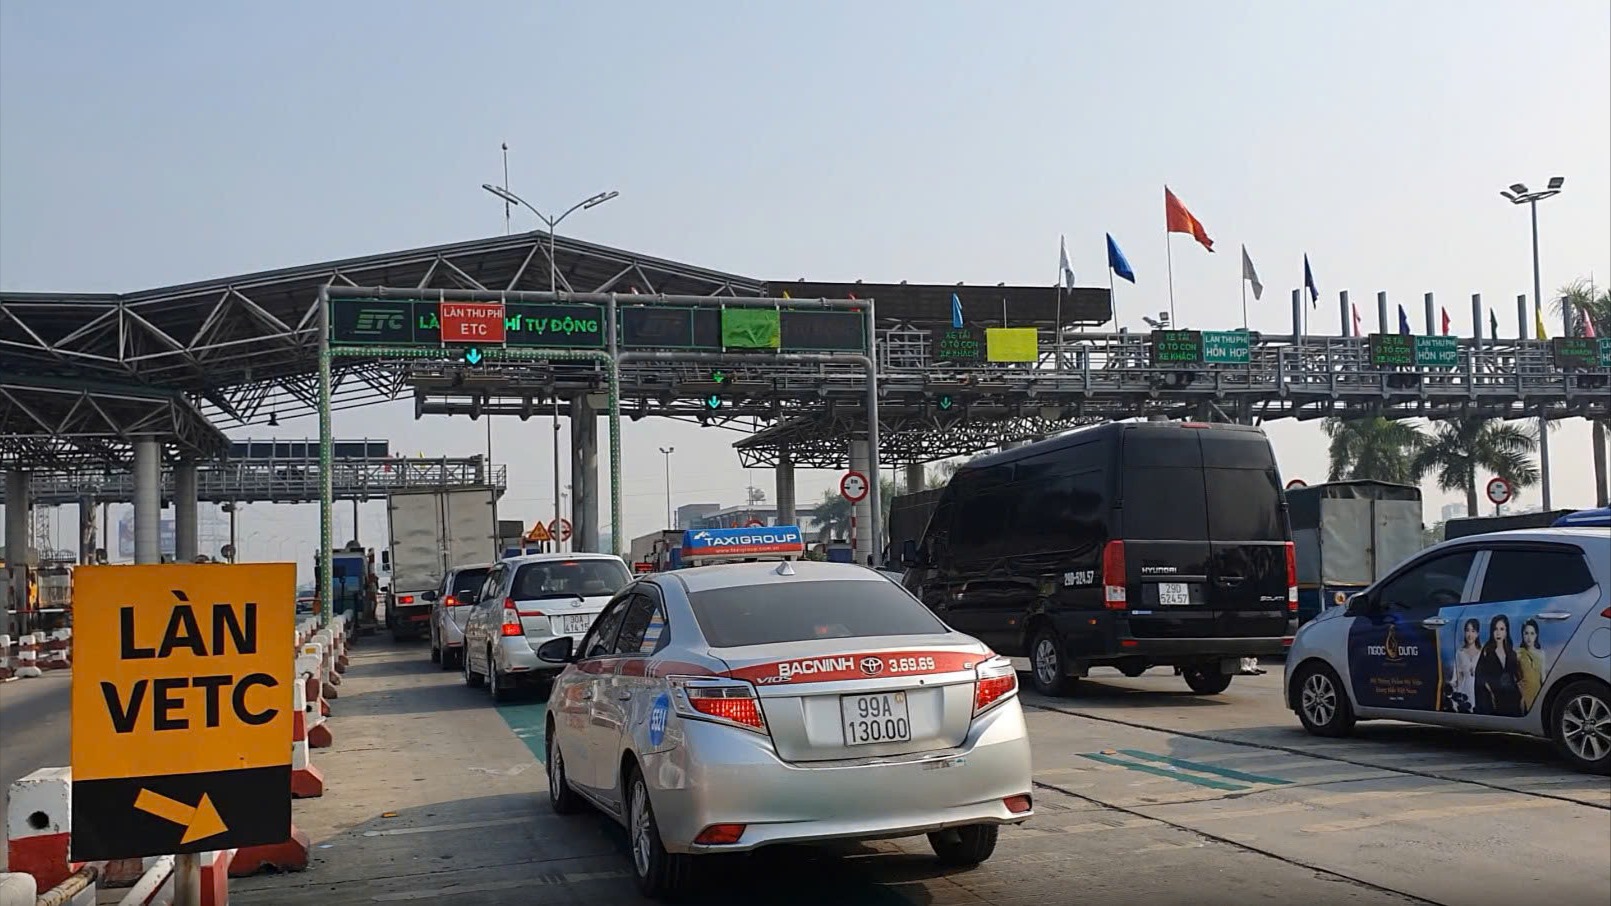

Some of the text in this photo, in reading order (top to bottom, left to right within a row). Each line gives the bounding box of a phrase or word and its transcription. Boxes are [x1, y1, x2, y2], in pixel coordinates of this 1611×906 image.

[355, 310, 405, 331] ETC
[443, 306, 503, 319] LÀN THU PHÍ
[420, 312, 597, 335] LÀ HÍ TỰ ĐỘNG
[461, 323, 487, 335] ETC
[1206, 334, 1220, 343] LÀN
[1165, 584, 1182, 593] 29D
[120, 590, 257, 660] LÀN
[778, 656, 935, 677] BACNINH 3.69.69
[100, 672, 279, 733] VETC
[858, 697, 892, 718] 99A
[849, 717, 908, 743] 130.00
